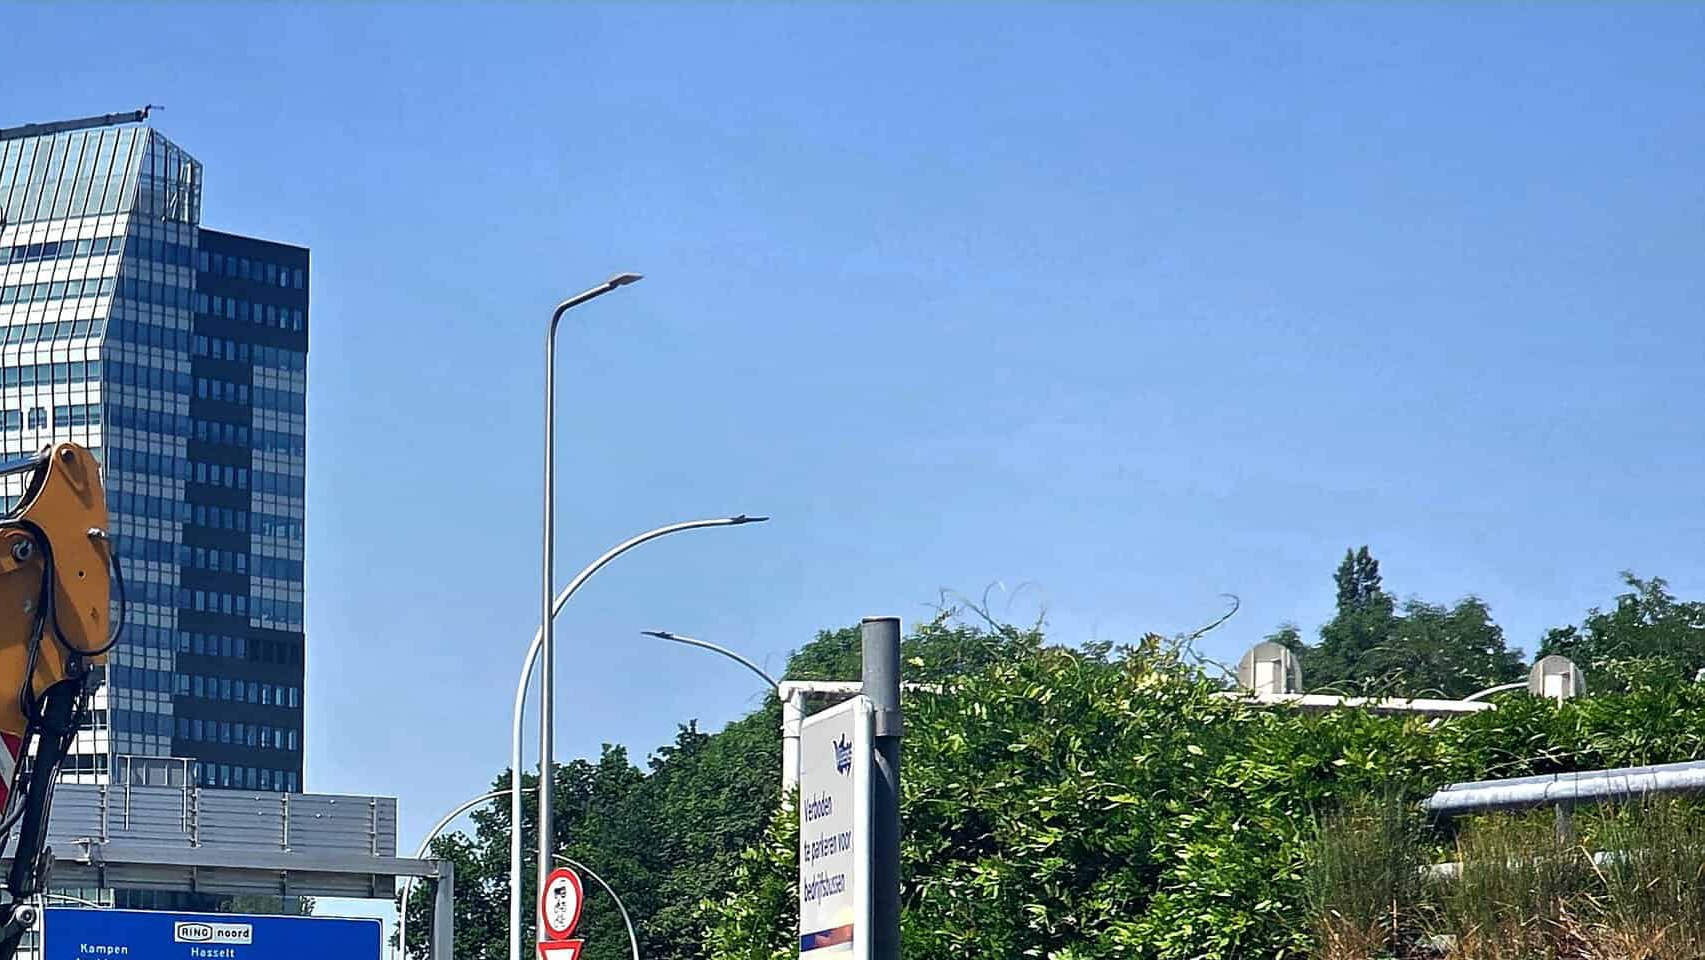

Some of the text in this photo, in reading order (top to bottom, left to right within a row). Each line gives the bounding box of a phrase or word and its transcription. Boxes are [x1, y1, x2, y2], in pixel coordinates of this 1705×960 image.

[804, 790, 832, 822] Verboden
[811, 832, 837, 866] parkeren
[838, 830, 851, 852] voor
[804, 870, 845, 906] bedrijfsbussen
[182, 928, 250, 938] RING noord
[80, 943, 128, 955] Kampen
[191, 946, 235, 958] Hasselt
